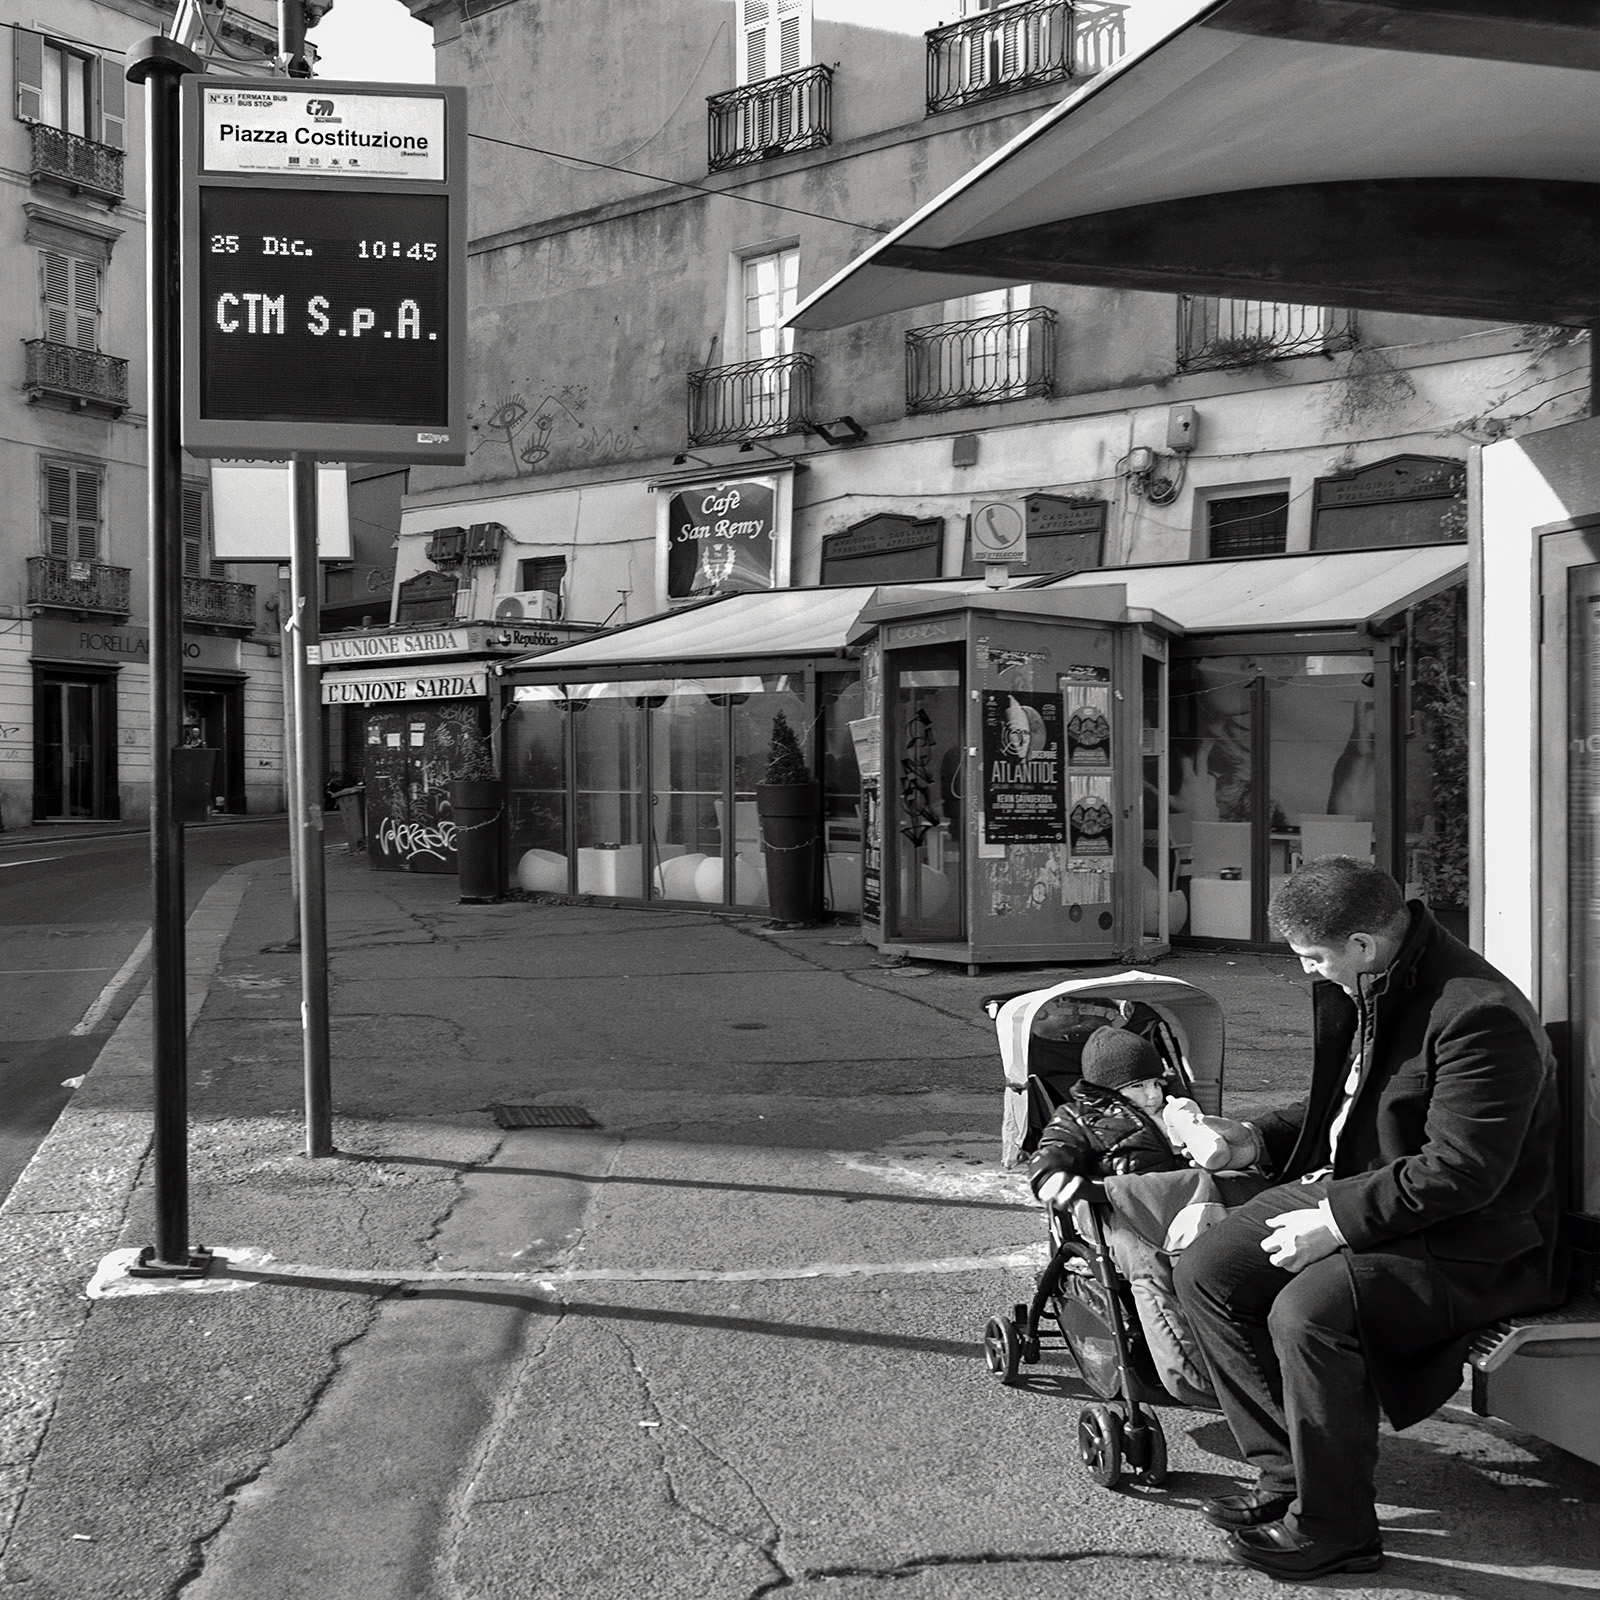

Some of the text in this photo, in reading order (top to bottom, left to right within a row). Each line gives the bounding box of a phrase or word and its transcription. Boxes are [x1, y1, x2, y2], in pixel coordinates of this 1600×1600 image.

[222, 95, 234, 105] 51
[237, 94, 288, 103] FERMATA BUS
[237, 100, 273, 109] BUS STOP
[220, 123, 429, 150] Piazza Costituzione
[211, 235, 437, 261] 25 Dic. 10:45
[217, 293, 437, 340] CTM S.p.A.
[677, 519, 764, 543] San Remy
[329, 636, 399, 658] L'UNIONE
[403, 631, 458, 653] SARDA
[513, 630, 558, 647] Repubblica
[328, 676, 478, 703] L'UNIONE SARDA
[992, 760, 1058, 784] ATLANTIDE
